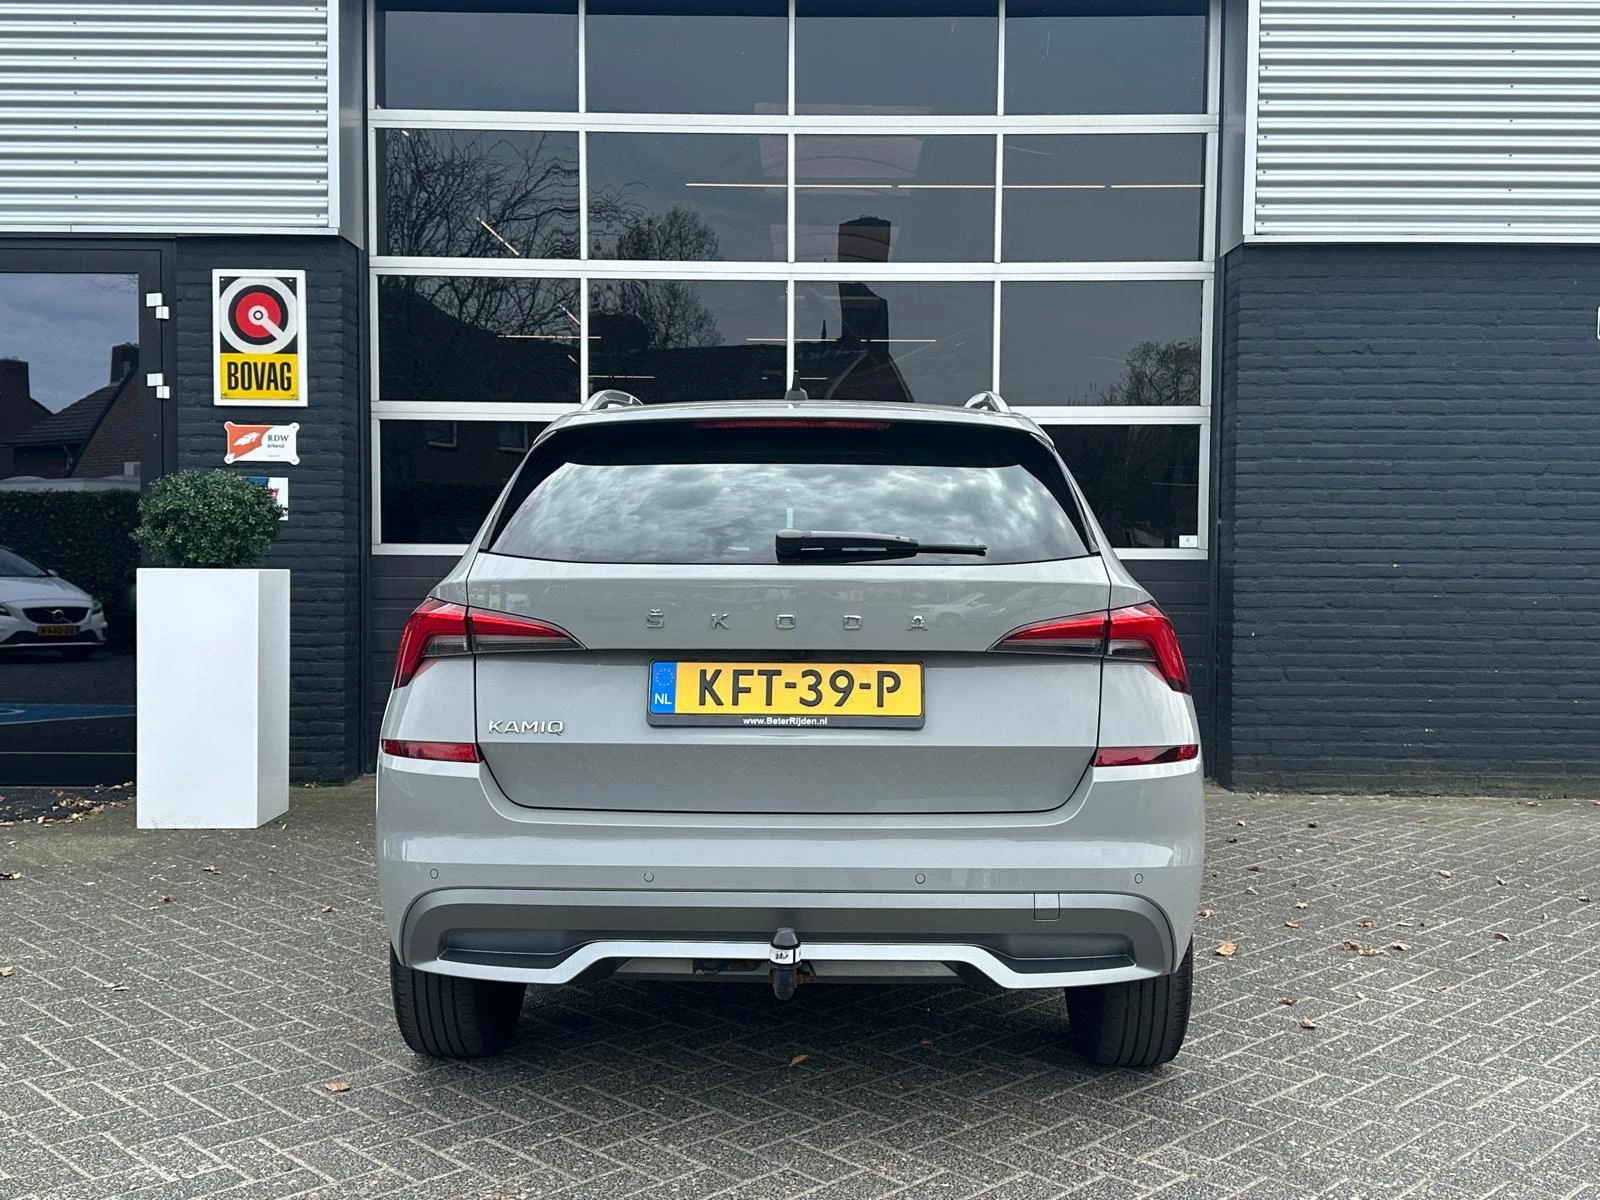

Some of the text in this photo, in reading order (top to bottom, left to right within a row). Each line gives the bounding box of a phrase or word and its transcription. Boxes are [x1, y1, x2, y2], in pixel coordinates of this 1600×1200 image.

[227, 361, 292, 391] BOVAG
[267, 434, 289, 442] RDW
[698, 669, 901, 708] KFT-39-P
[654, 693, 673, 705] NL
[488, 720, 565, 736] KAMIQ
[742, 716, 828, 727] www.BeterRijden.nl
